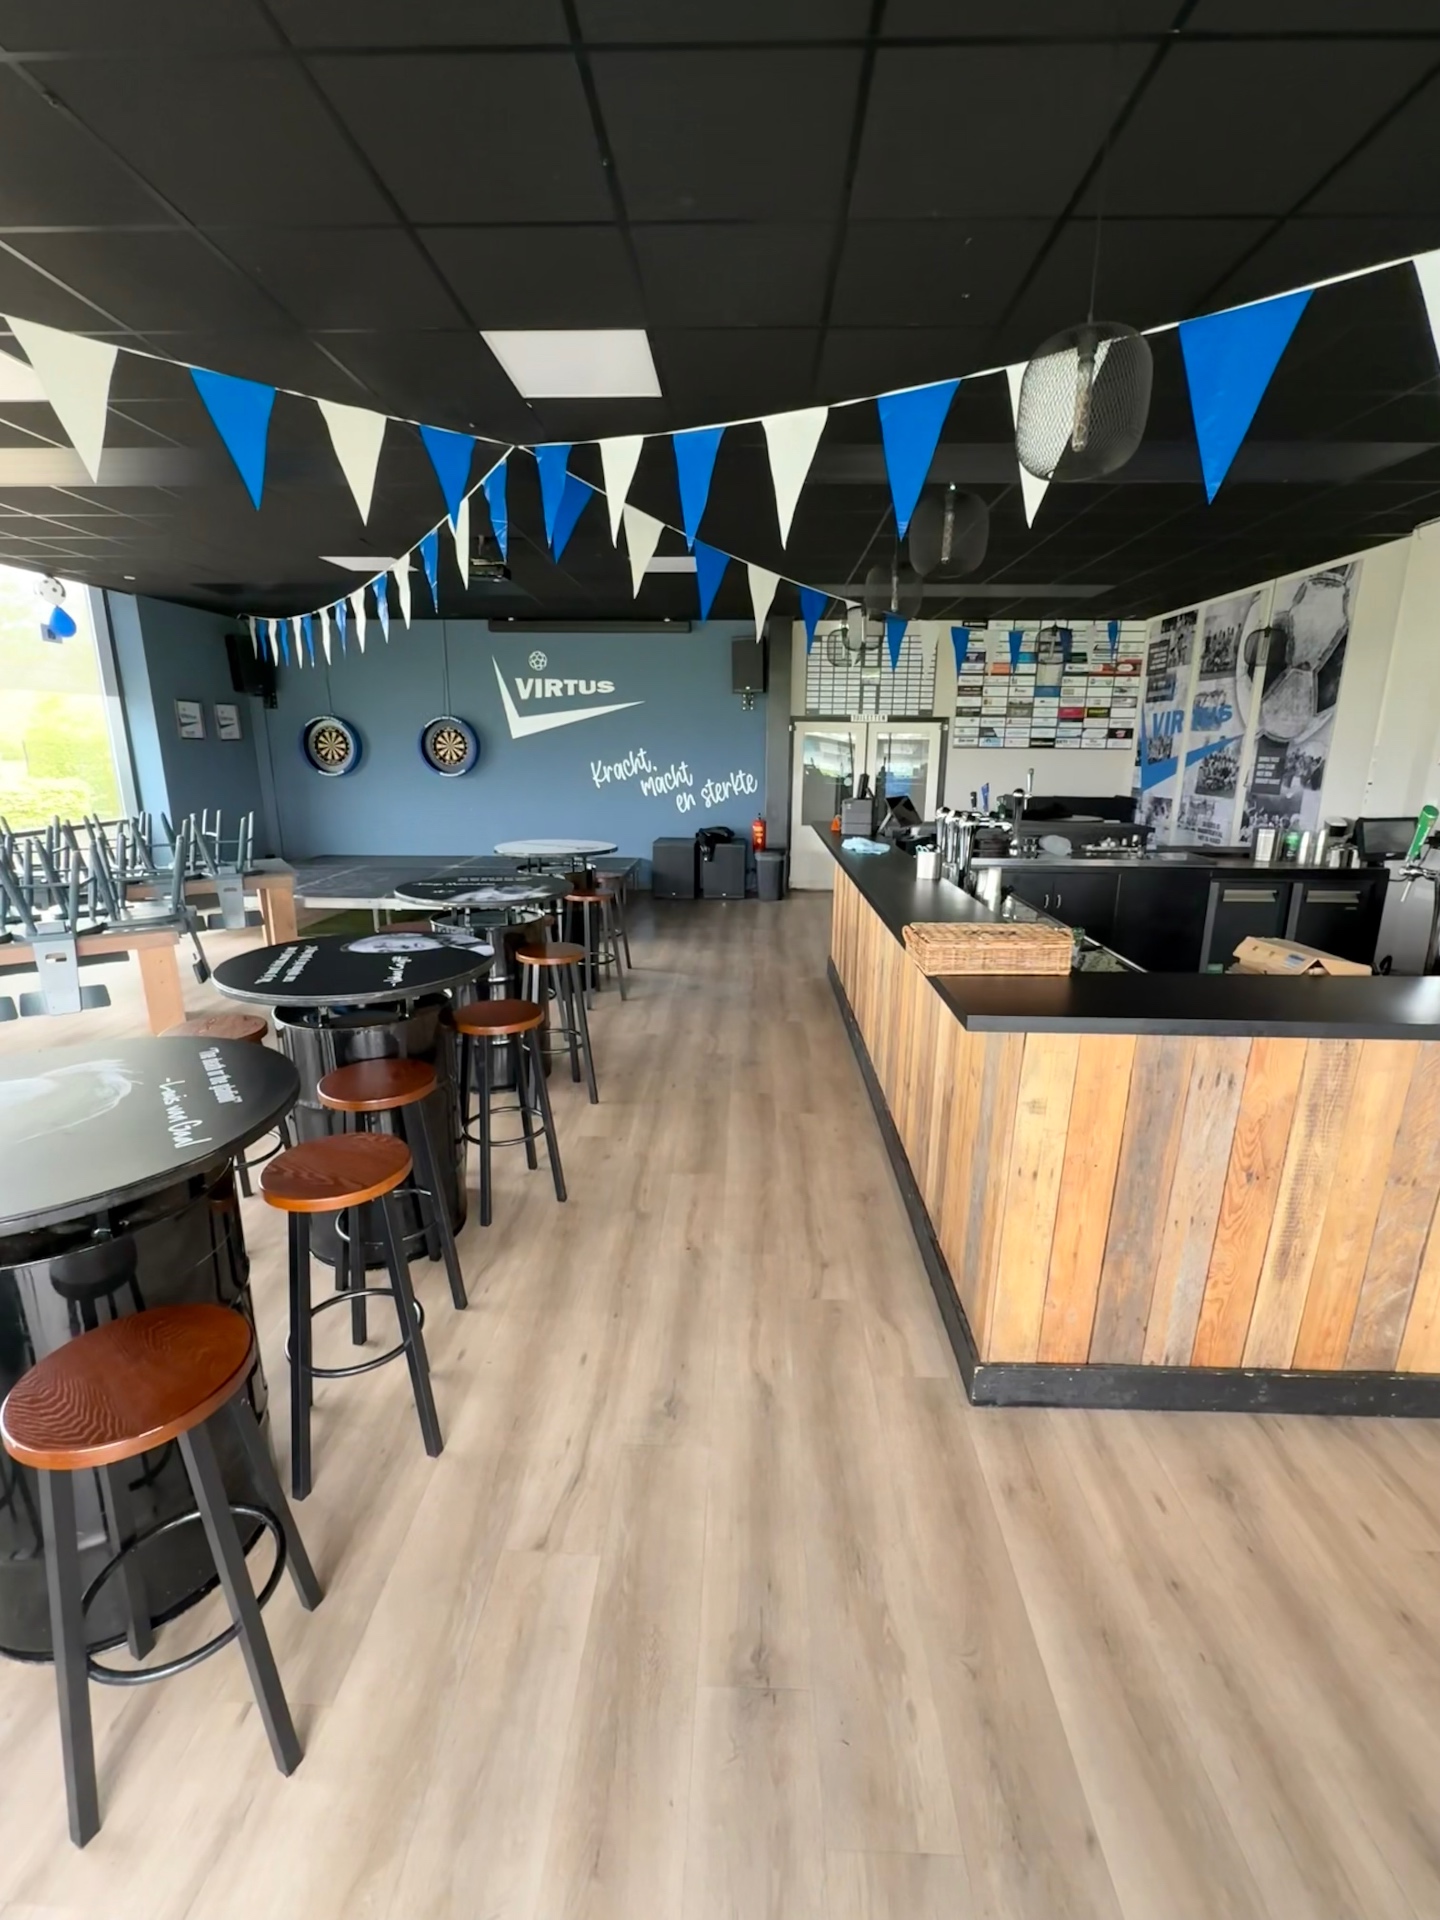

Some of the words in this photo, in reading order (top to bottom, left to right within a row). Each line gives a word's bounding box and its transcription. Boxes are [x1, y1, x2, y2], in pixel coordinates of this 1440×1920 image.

[514, 677, 616, 700] VIRTUS
[640, 761, 694, 797] macht
[675, 792, 697, 813] en
[700, 769, 758, 808] sterkte
